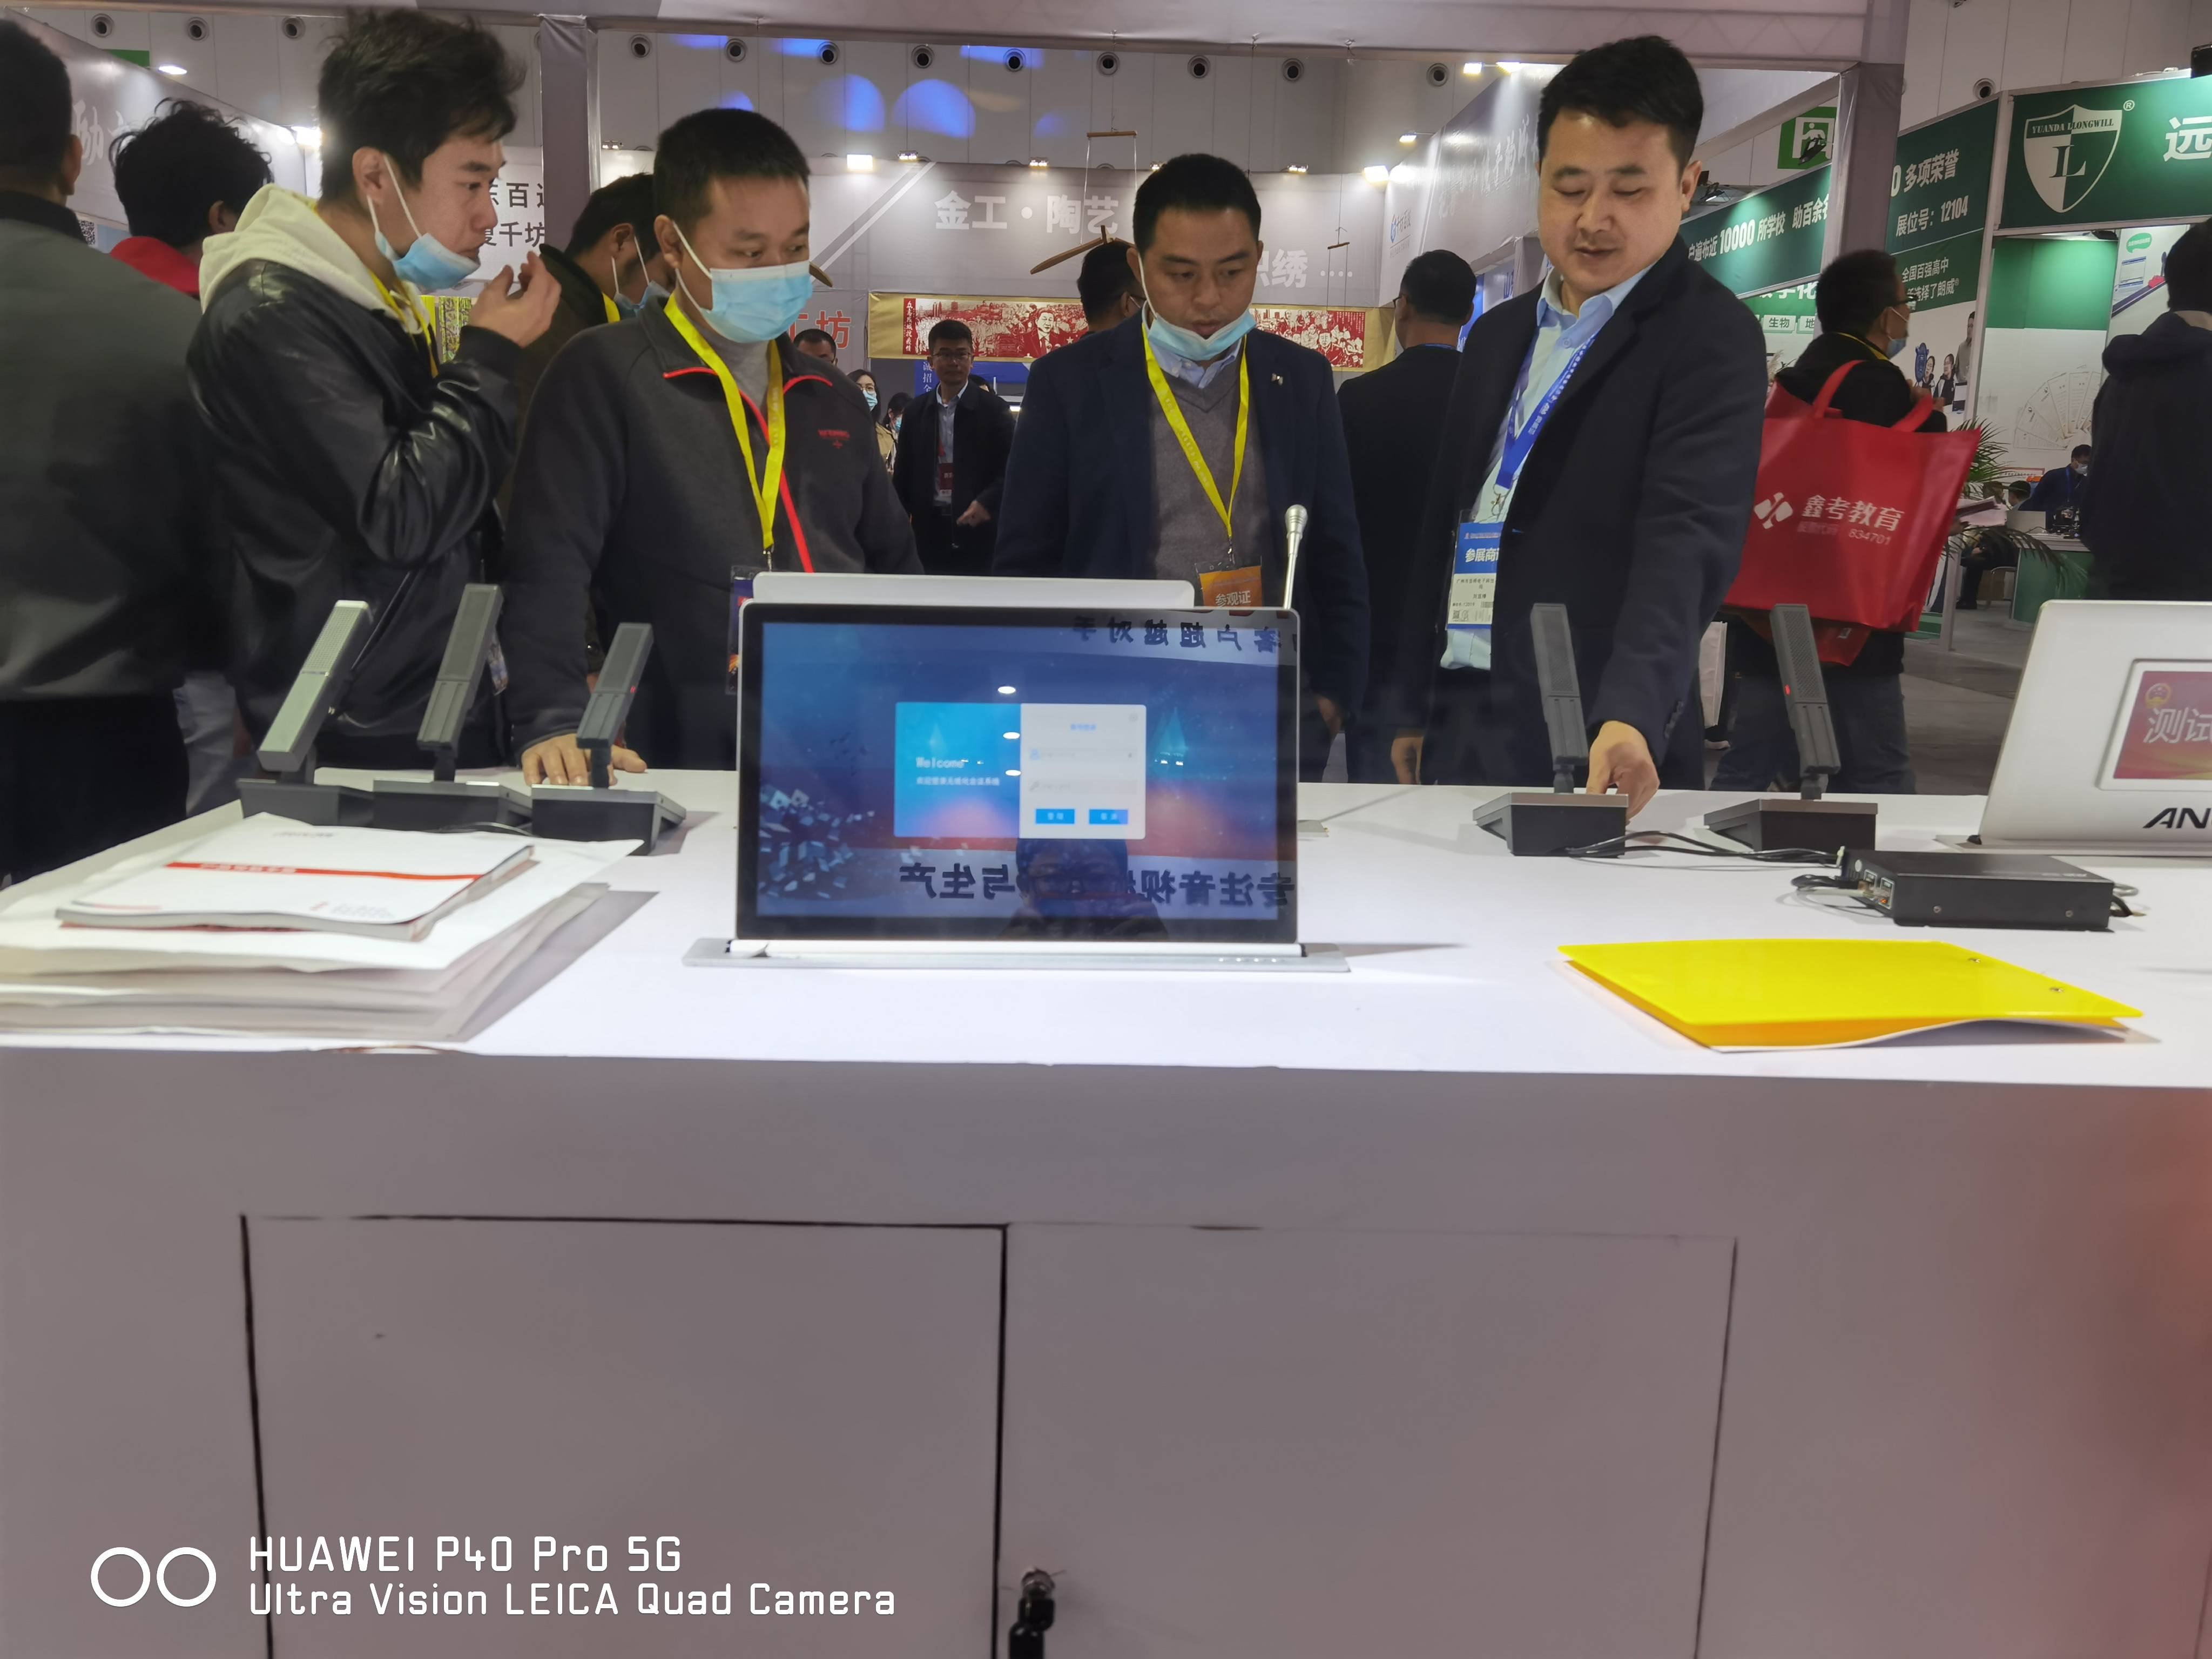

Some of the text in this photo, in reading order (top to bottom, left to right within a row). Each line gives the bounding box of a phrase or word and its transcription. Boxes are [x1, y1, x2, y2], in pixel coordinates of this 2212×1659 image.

[2032, 123, 2065, 134] YUANDA
[1904, 149, 1959, 193] 多项荣誉
[934, 190, 1119, 234] 金工·陶艺
[1719, 219, 1755, 254] 10000
[1757, 211, 1786, 242] 所学校
[1901, 257, 1949, 283] 全国百强高中
[1769, 318, 1790, 328] 生物
[1802, 495, 1905, 532] 鑫考教育
[1849, 528, 1891, 545] 834701
[1465, 548, 1500, 563] 参展商
[1215, 590, 1251, 607] 参观证
[916, 757, 965, 769] Welcome
[2142, 807, 2212, 829] AN
